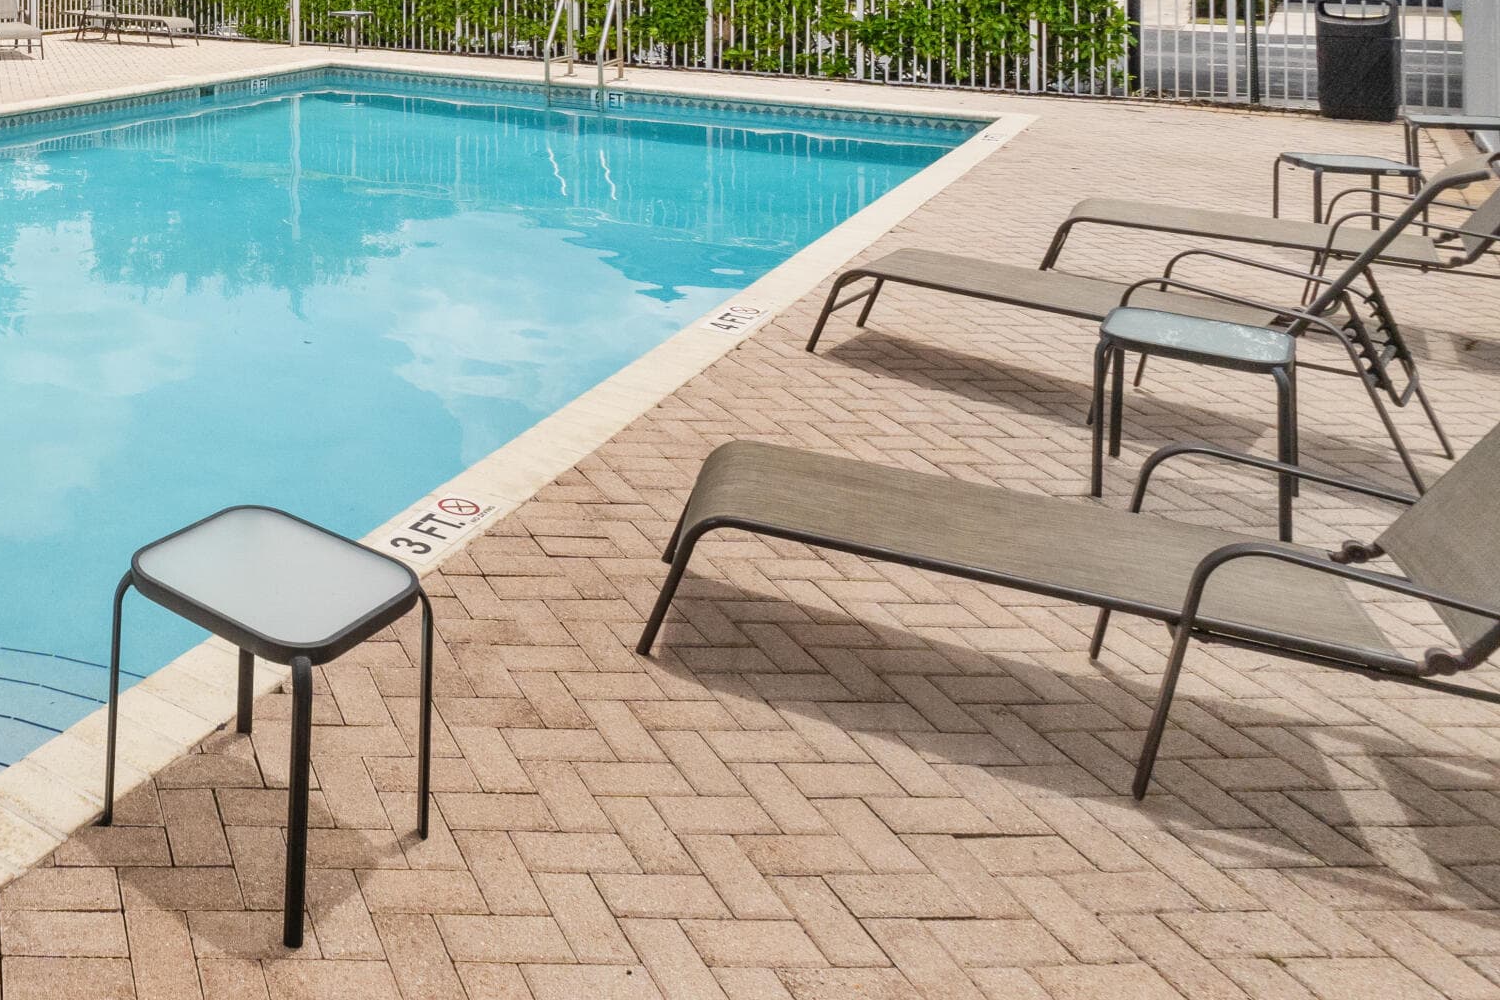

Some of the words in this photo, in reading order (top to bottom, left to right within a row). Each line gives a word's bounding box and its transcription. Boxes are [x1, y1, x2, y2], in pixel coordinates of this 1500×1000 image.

[260, 79, 267, 88] FT
[609, 93, 623, 102] FT
[709, 322, 739, 330] 4
[390, 537, 432, 555] 3
